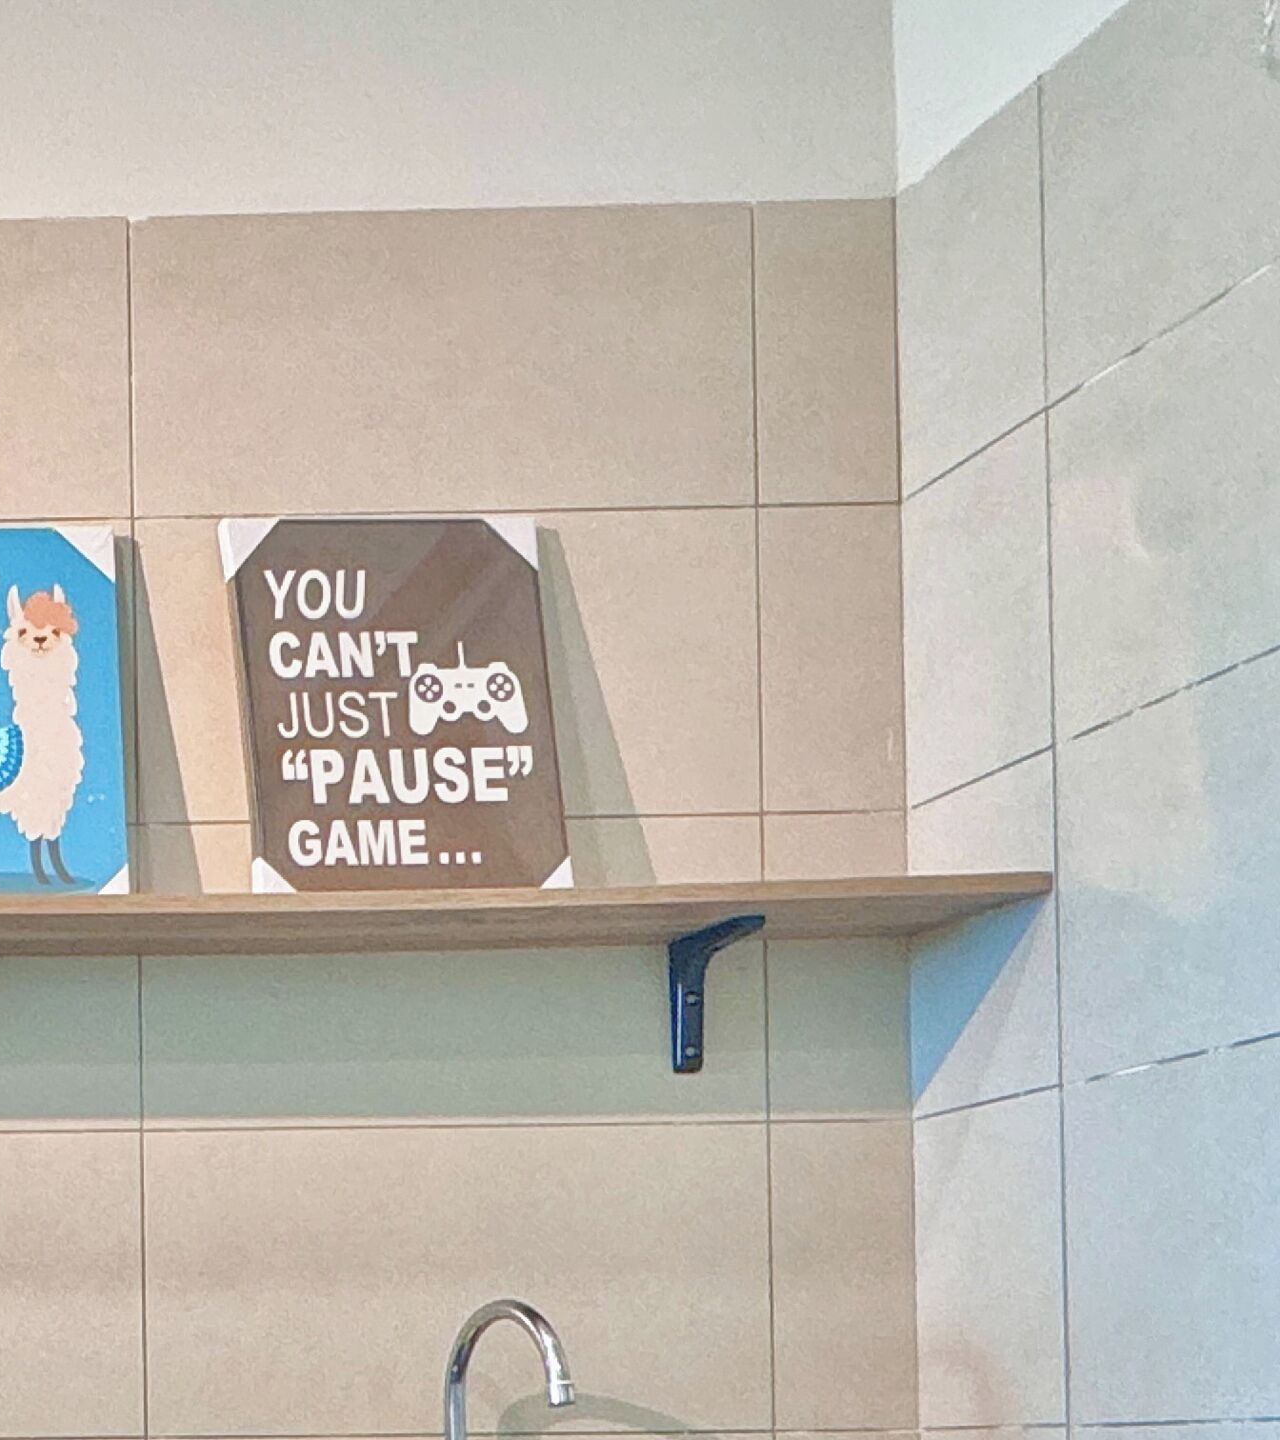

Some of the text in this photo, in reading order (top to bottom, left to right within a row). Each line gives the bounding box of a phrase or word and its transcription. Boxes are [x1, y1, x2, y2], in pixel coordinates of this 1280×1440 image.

[263, 569, 367, 620] YOU
[268, 630, 418, 679] CAN'T
[277, 691, 398, 739] JUST
[281, 746, 533, 805] "PAUSE"
